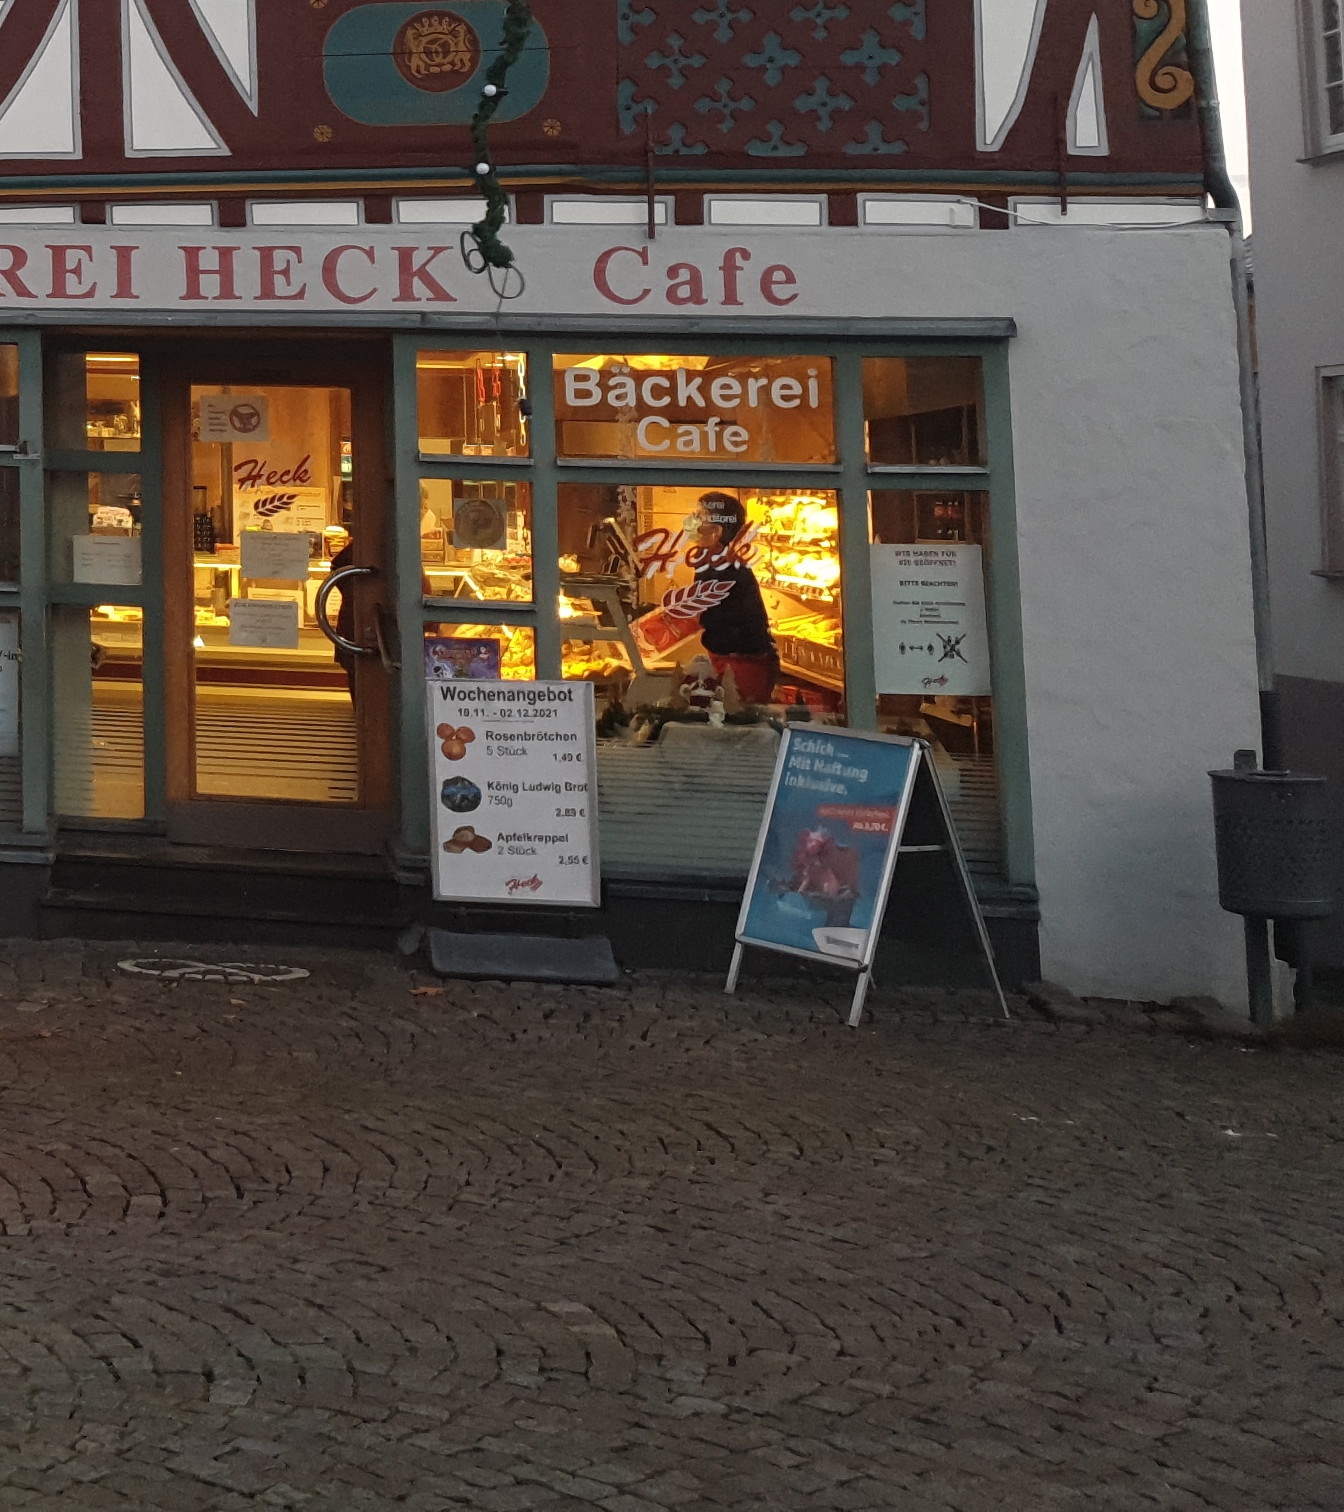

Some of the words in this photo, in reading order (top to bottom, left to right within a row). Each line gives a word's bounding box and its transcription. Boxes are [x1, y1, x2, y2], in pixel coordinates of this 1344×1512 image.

[177, 244, 458, 305] HECK
[592, 245, 800, 307] Cafe
[564, 366, 819, 409] Bäckerei
[637, 415, 749, 453] Cafe
[233, 454, 311, 490] Heck
[633, 518, 760, 581] Heck
[440, 686, 574, 706] Wochenangebot
[499, 707, 558, 719] 02.12.2021
[485, 730, 578, 742] Rosenbrötchen
[497, 745, 528, 756] Stück
[487, 780, 519, 793] König
[522, 781, 562, 794] Ludwig
[564, 782, 588, 793] Brot
[487, 795, 513, 808] 750g
[507, 845, 538, 856] Stück
